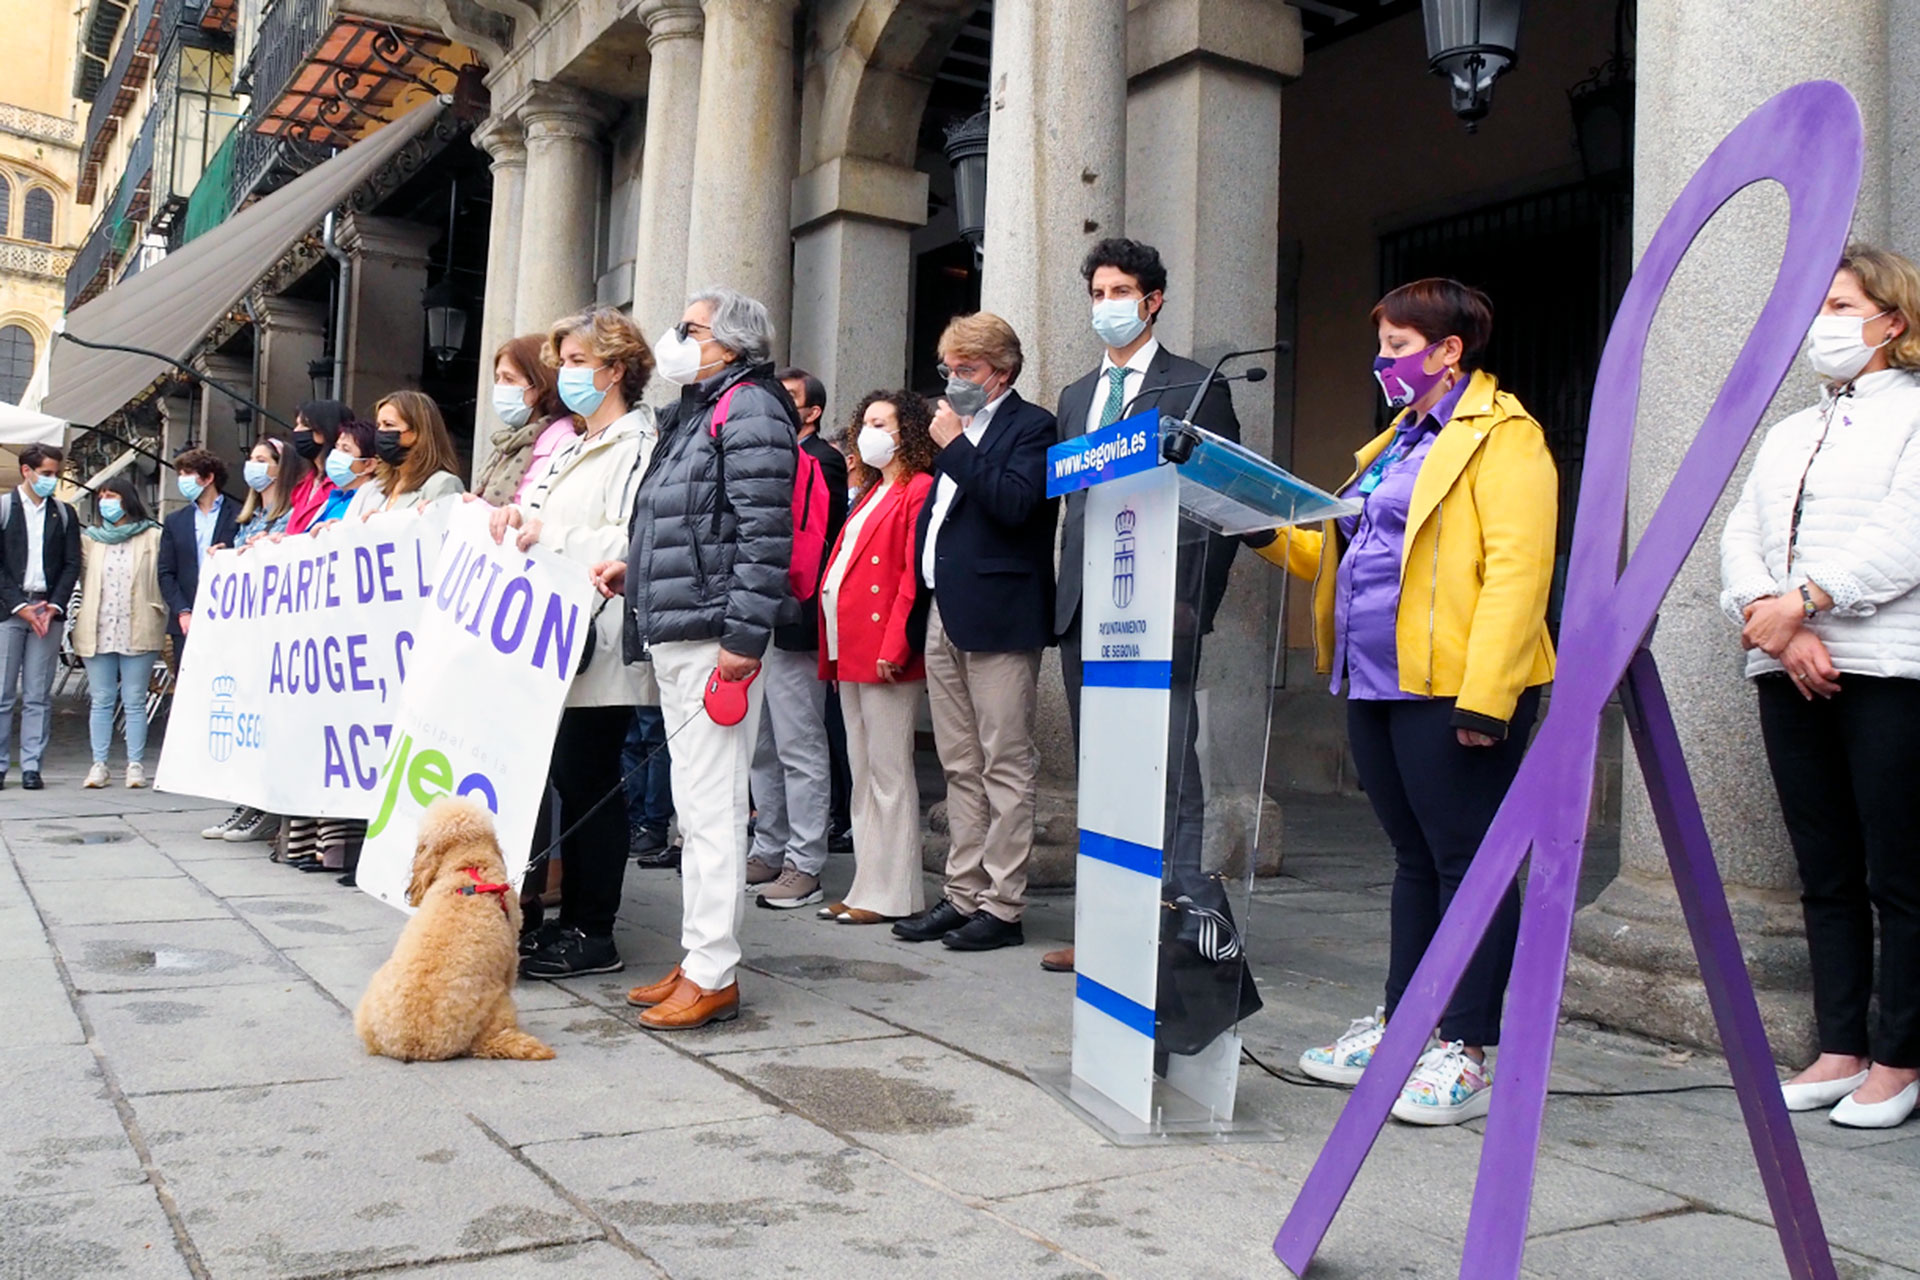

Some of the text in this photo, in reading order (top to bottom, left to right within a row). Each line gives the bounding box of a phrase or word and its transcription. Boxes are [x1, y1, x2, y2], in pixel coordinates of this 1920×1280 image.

[1055, 430, 1146, 478] www.segovia.es
[354, 542, 402, 604] DE
[436, 541, 579, 681] UCIÓN
[1099, 619, 1146, 635] AYUNTAMIENTO
[269, 634, 387, 703] ACOGE,
[1101, 644, 1140, 658] DE SEGOVIA
[236, 712, 263, 749] SEG
